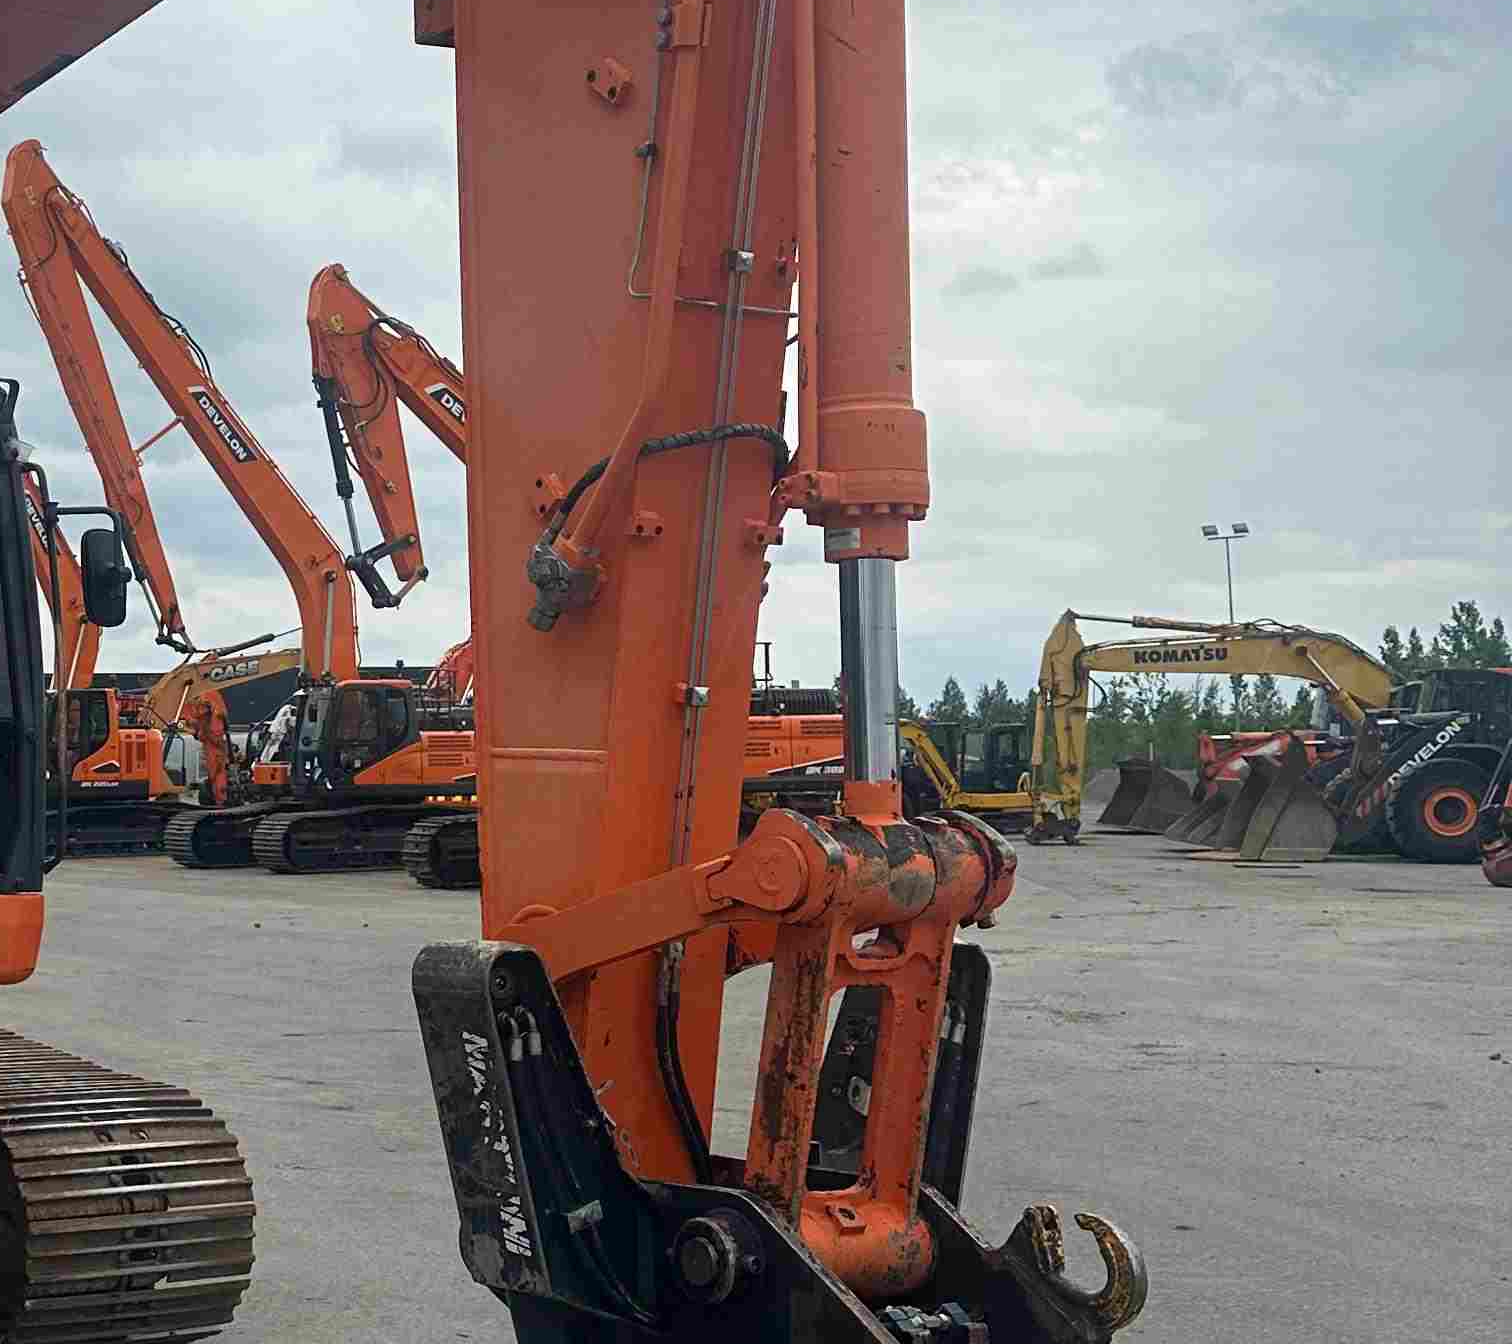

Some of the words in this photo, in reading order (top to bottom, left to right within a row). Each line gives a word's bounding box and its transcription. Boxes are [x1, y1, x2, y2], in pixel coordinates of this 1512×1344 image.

[440, 393, 465, 422] DE
[199, 396, 248, 461] DEVELON
[1134, 647, 1228, 664] KOMATSU
[209, 661, 259, 681] CASE
[1388, 721, 1462, 785] DEVELON
